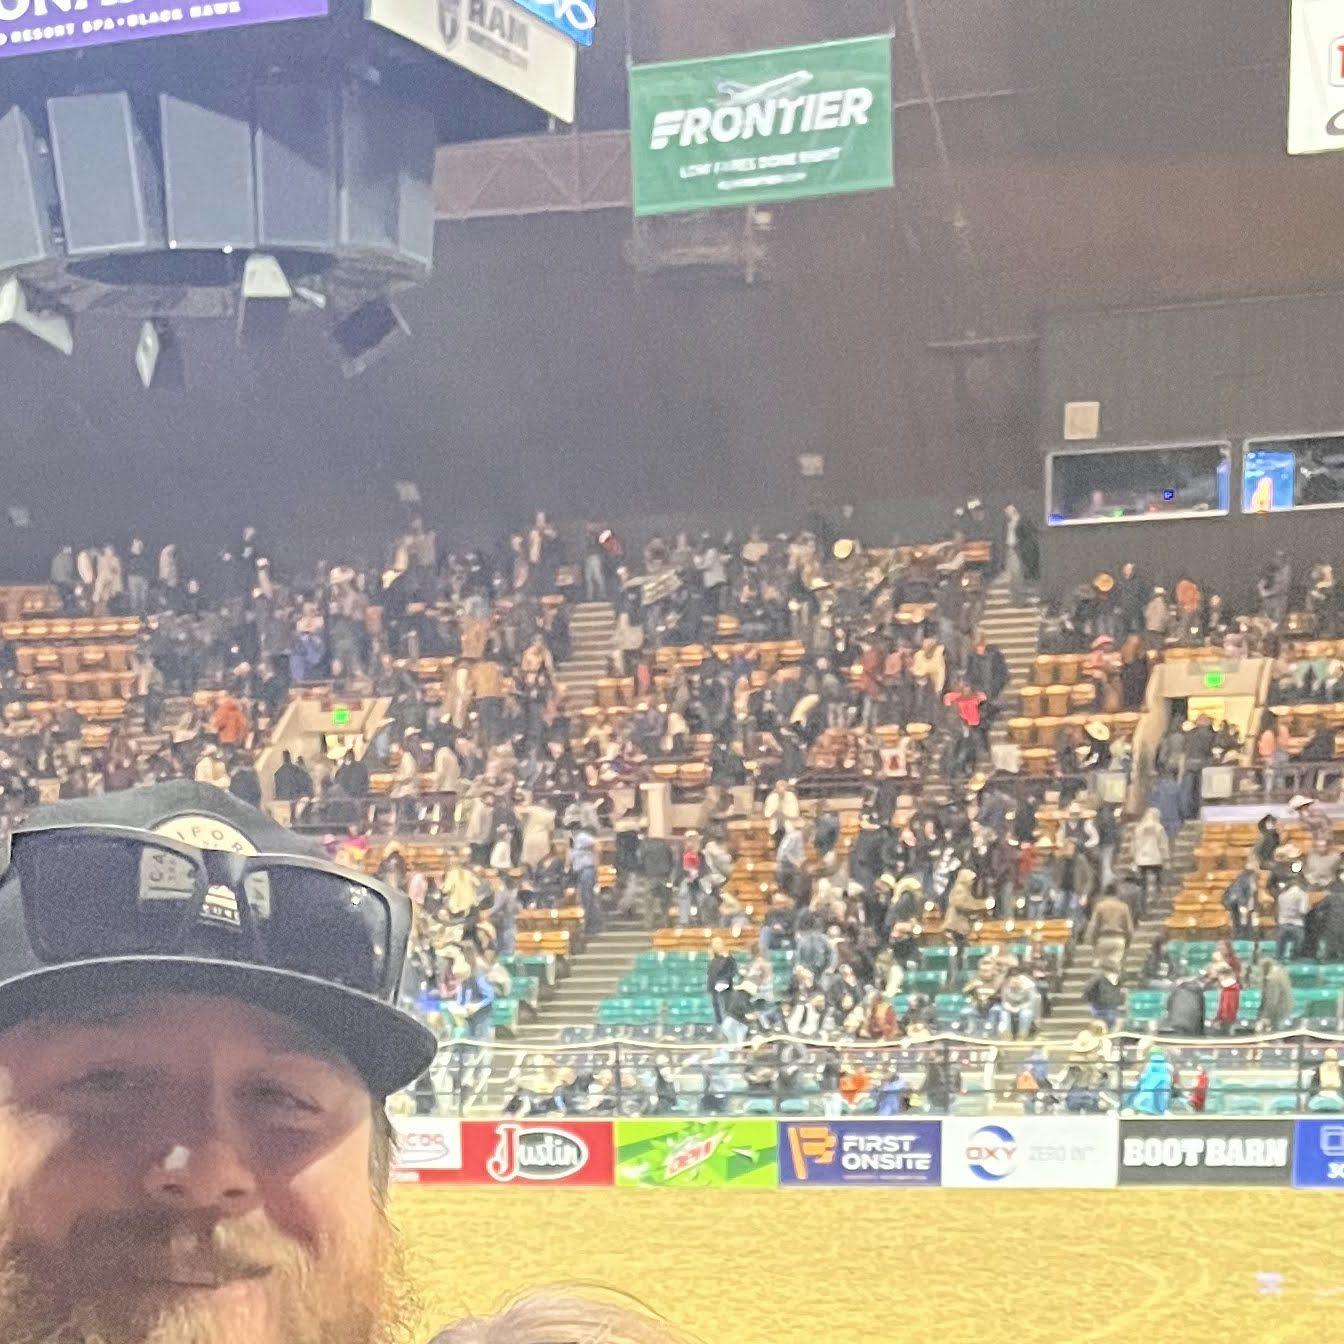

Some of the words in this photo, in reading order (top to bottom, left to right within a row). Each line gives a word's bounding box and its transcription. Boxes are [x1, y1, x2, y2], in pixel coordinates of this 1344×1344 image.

[649, 86, 874, 151] FRONTIER
[487, 1124, 584, 1182] Justin
[841, 1135, 920, 1152] FIRST
[965, 1146, 1018, 1161] OXY
[1123, 1138, 1205, 1167] BOOT
[1205, 1138, 1288, 1168] BARN
[841, 1153, 933, 1171] ONSITE
